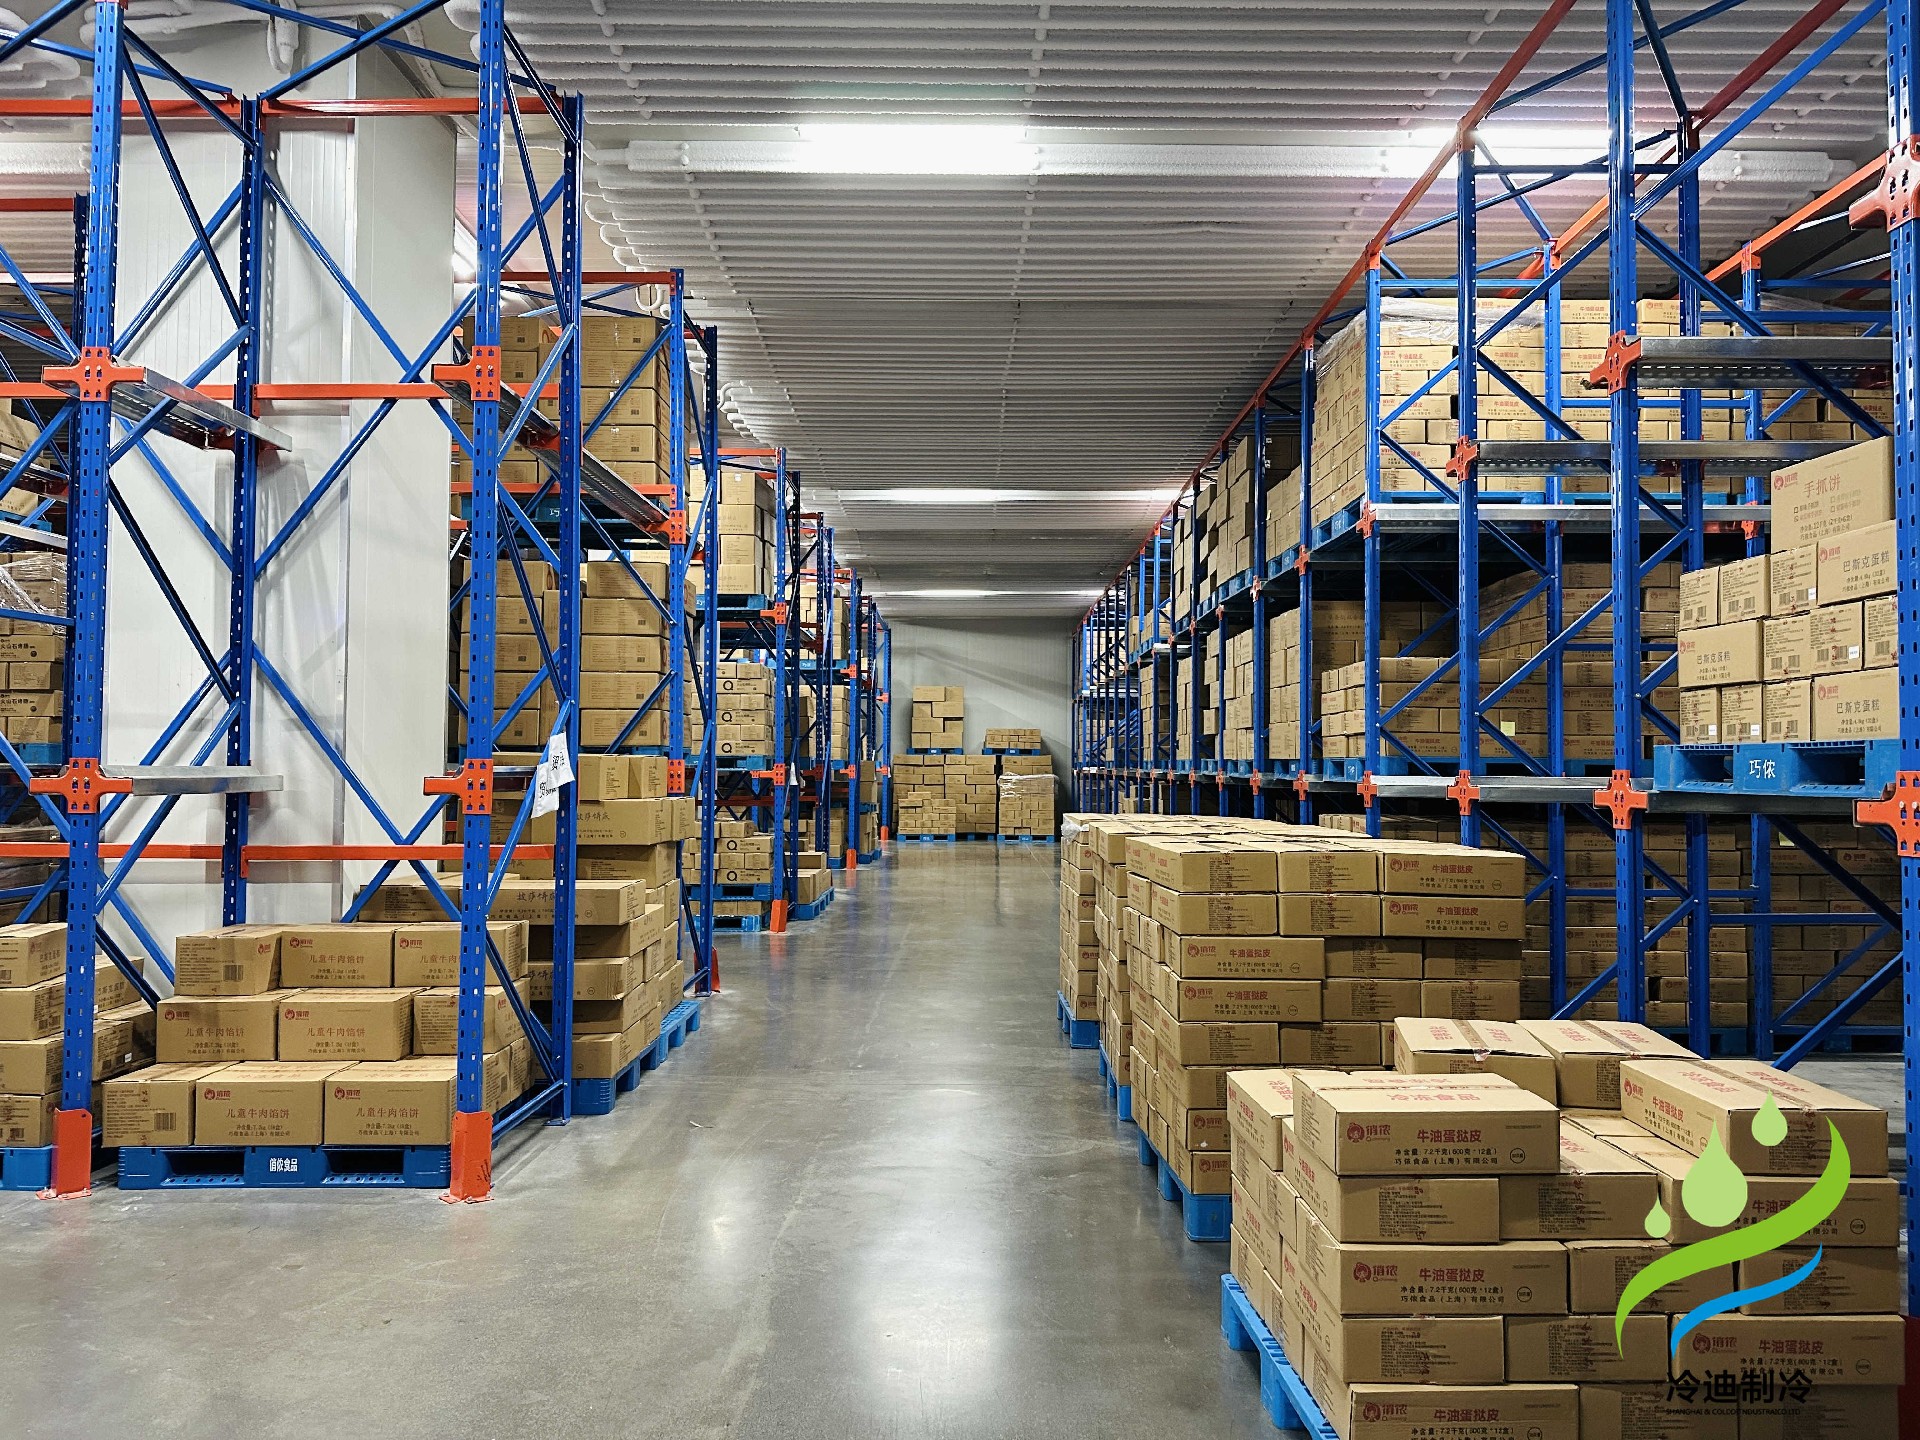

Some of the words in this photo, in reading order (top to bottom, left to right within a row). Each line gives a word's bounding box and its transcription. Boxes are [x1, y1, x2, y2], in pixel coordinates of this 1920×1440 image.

[1803, 474, 1841, 498] 手抓饼
[1842, 550, 1890, 573] 巴斯克蛋糕
[1836, 699, 1880, 714] 巴斯克蛋糕
[1749, 759, 1776, 779] 巧侬
[1437, 906, 1479, 916] 牛油蛋挞皮
[1229, 948, 1271, 958] 牛油蛋挞皮
[309, 955, 365, 964] 儿童牛肉馅饼
[420, 955, 460, 964] 儿童牛肉
[1226, 990, 1269, 1000] 牛油蛋挞皮
[307, 1027, 366, 1037] 儿童牛肉馅饼
[1386, 1093, 1481, 1102] 冷冻食品
[226, 1108, 290, 1119] 儿童牛肉馅饼
[355, 1107, 420, 1118] 儿童牛肉馅饼
[1416, 1129, 1482, 1143] 牛油蛋挞皮
[269, 1157, 298, 1173] 俏侬食品
[1419, 1267, 1485, 1282] 牛油蛋挞皮
[1758, 1339, 1824, 1355] 牛油蛋挞皮
[1434, 1408, 1500, 1422] 牛油蛋挞皮
